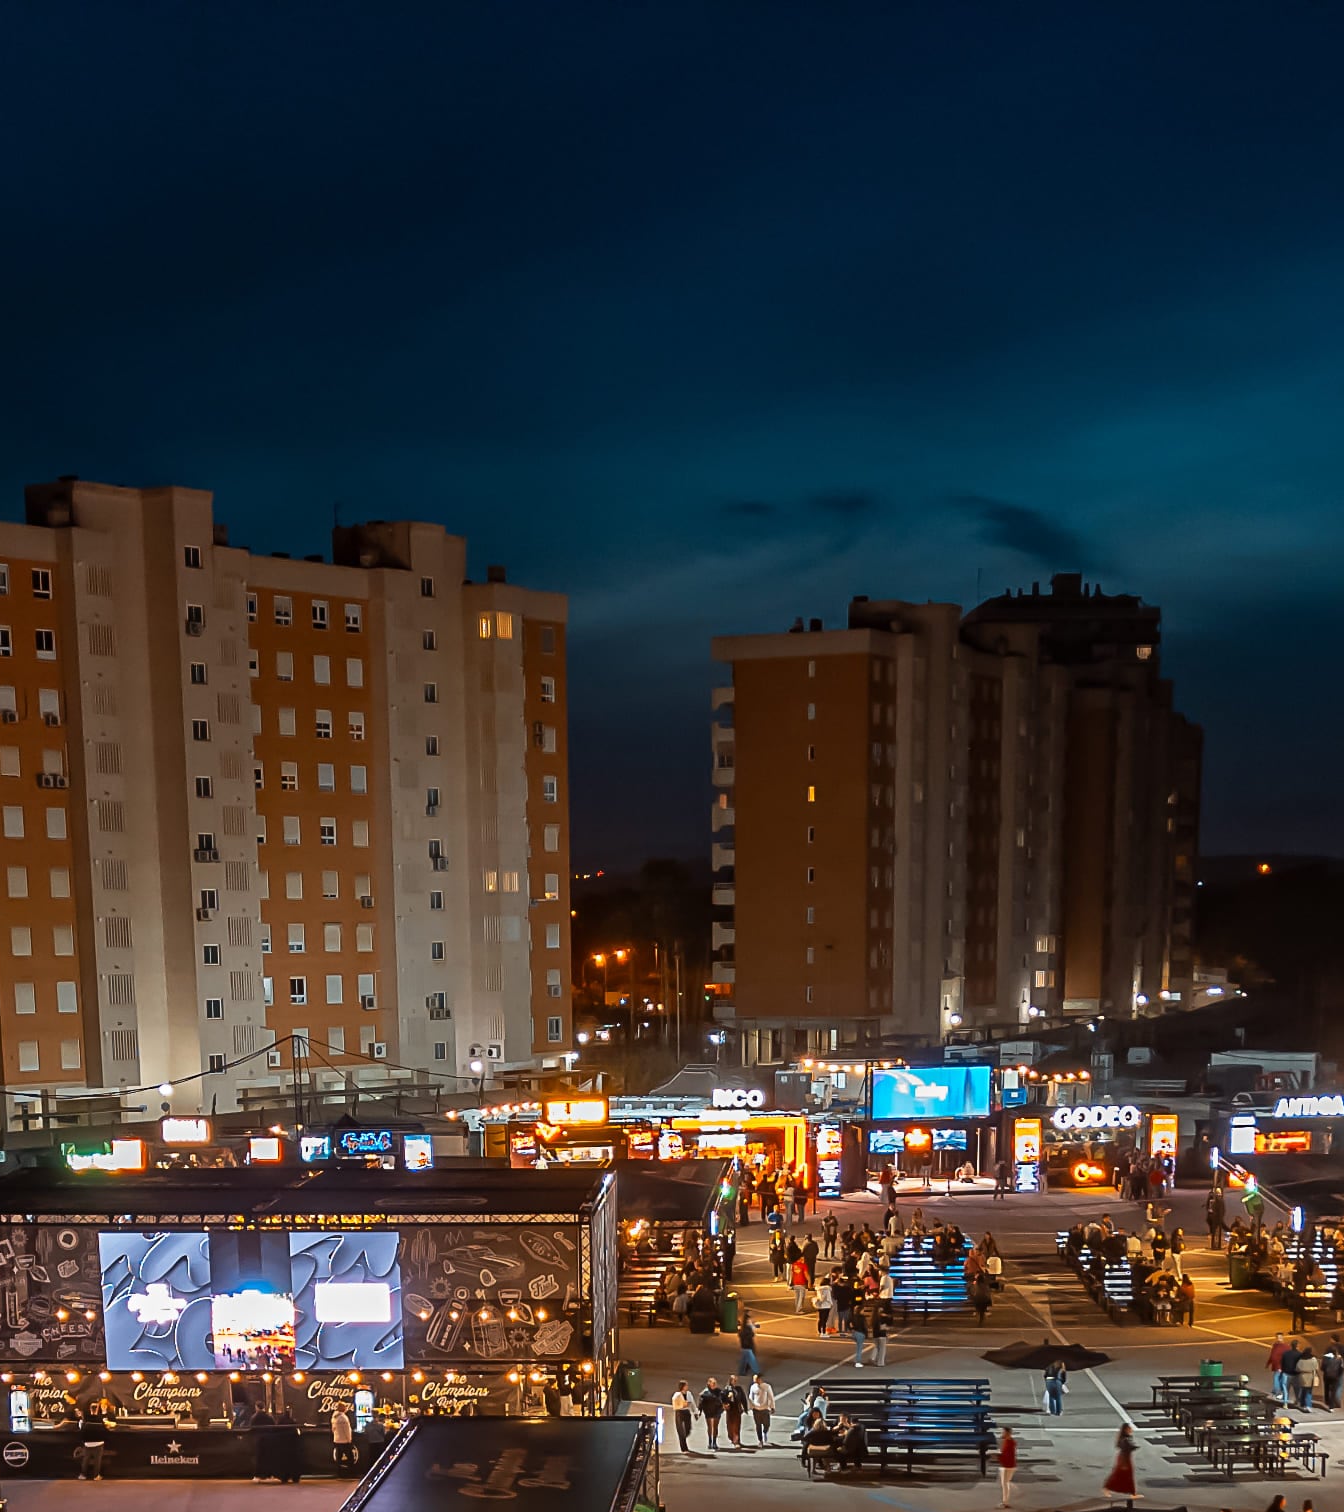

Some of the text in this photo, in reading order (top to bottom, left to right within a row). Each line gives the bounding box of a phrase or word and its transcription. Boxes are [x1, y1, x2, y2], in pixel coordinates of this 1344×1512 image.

[43, 1323, 93, 1337] CHEESY
[134, 1382, 203, 1401] Champions
[422, 1382, 490, 1400] Champions
[150, 1455, 200, 1465] Heineken
